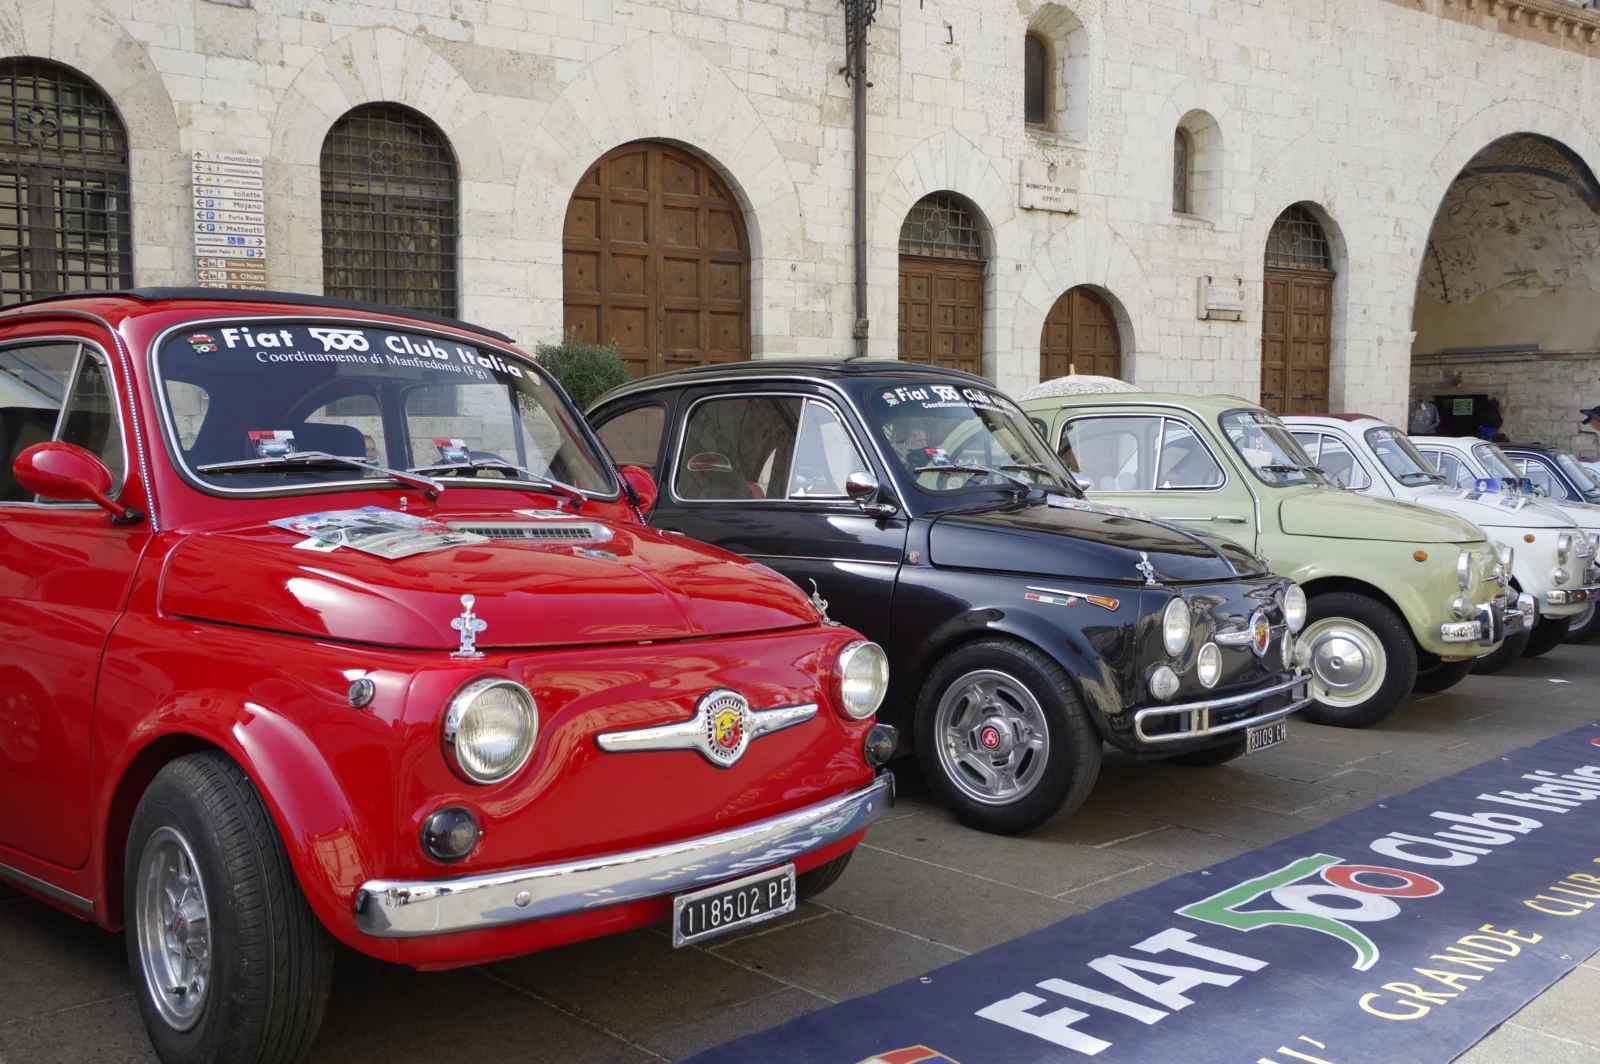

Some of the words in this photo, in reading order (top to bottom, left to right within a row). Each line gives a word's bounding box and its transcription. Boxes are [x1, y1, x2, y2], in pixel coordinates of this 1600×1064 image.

[224, 156, 260, 164] municipio
[233, 201, 262, 210] Mojano
[226, 225, 263, 234] Matteotti
[240, 273, 265, 281] Chiara
[221, 327, 293, 348] Fiat
[308, 328, 370, 352] 500
[385, 336, 449, 360] Club
[456, 347, 523, 378] Italia
[256, 352, 367, 363] Coordinamento
[371, 353, 384, 364] di
[385, 354, 461, 373] Manfredonia
[463, 366, 488, 379] (Fg)
[894, 387, 930, 402] Fiat
[930, 385, 960, 402] 500
[962, 389, 991, 404] Club
[1237, 415, 1255, 423] FIAT
[1252, 727, 1273, 749] 83109
[1276, 723, 1286, 741] CH
[688, 887, 760, 933] 118502
[768, 877, 789, 908] PE
[974, 927, 1270, 1056] FIAT
[1173, 853, 1445, 972] 500
[1369, 811, 1543, 867] Club
[1359, 924, 1543, 1020] GRANDE
